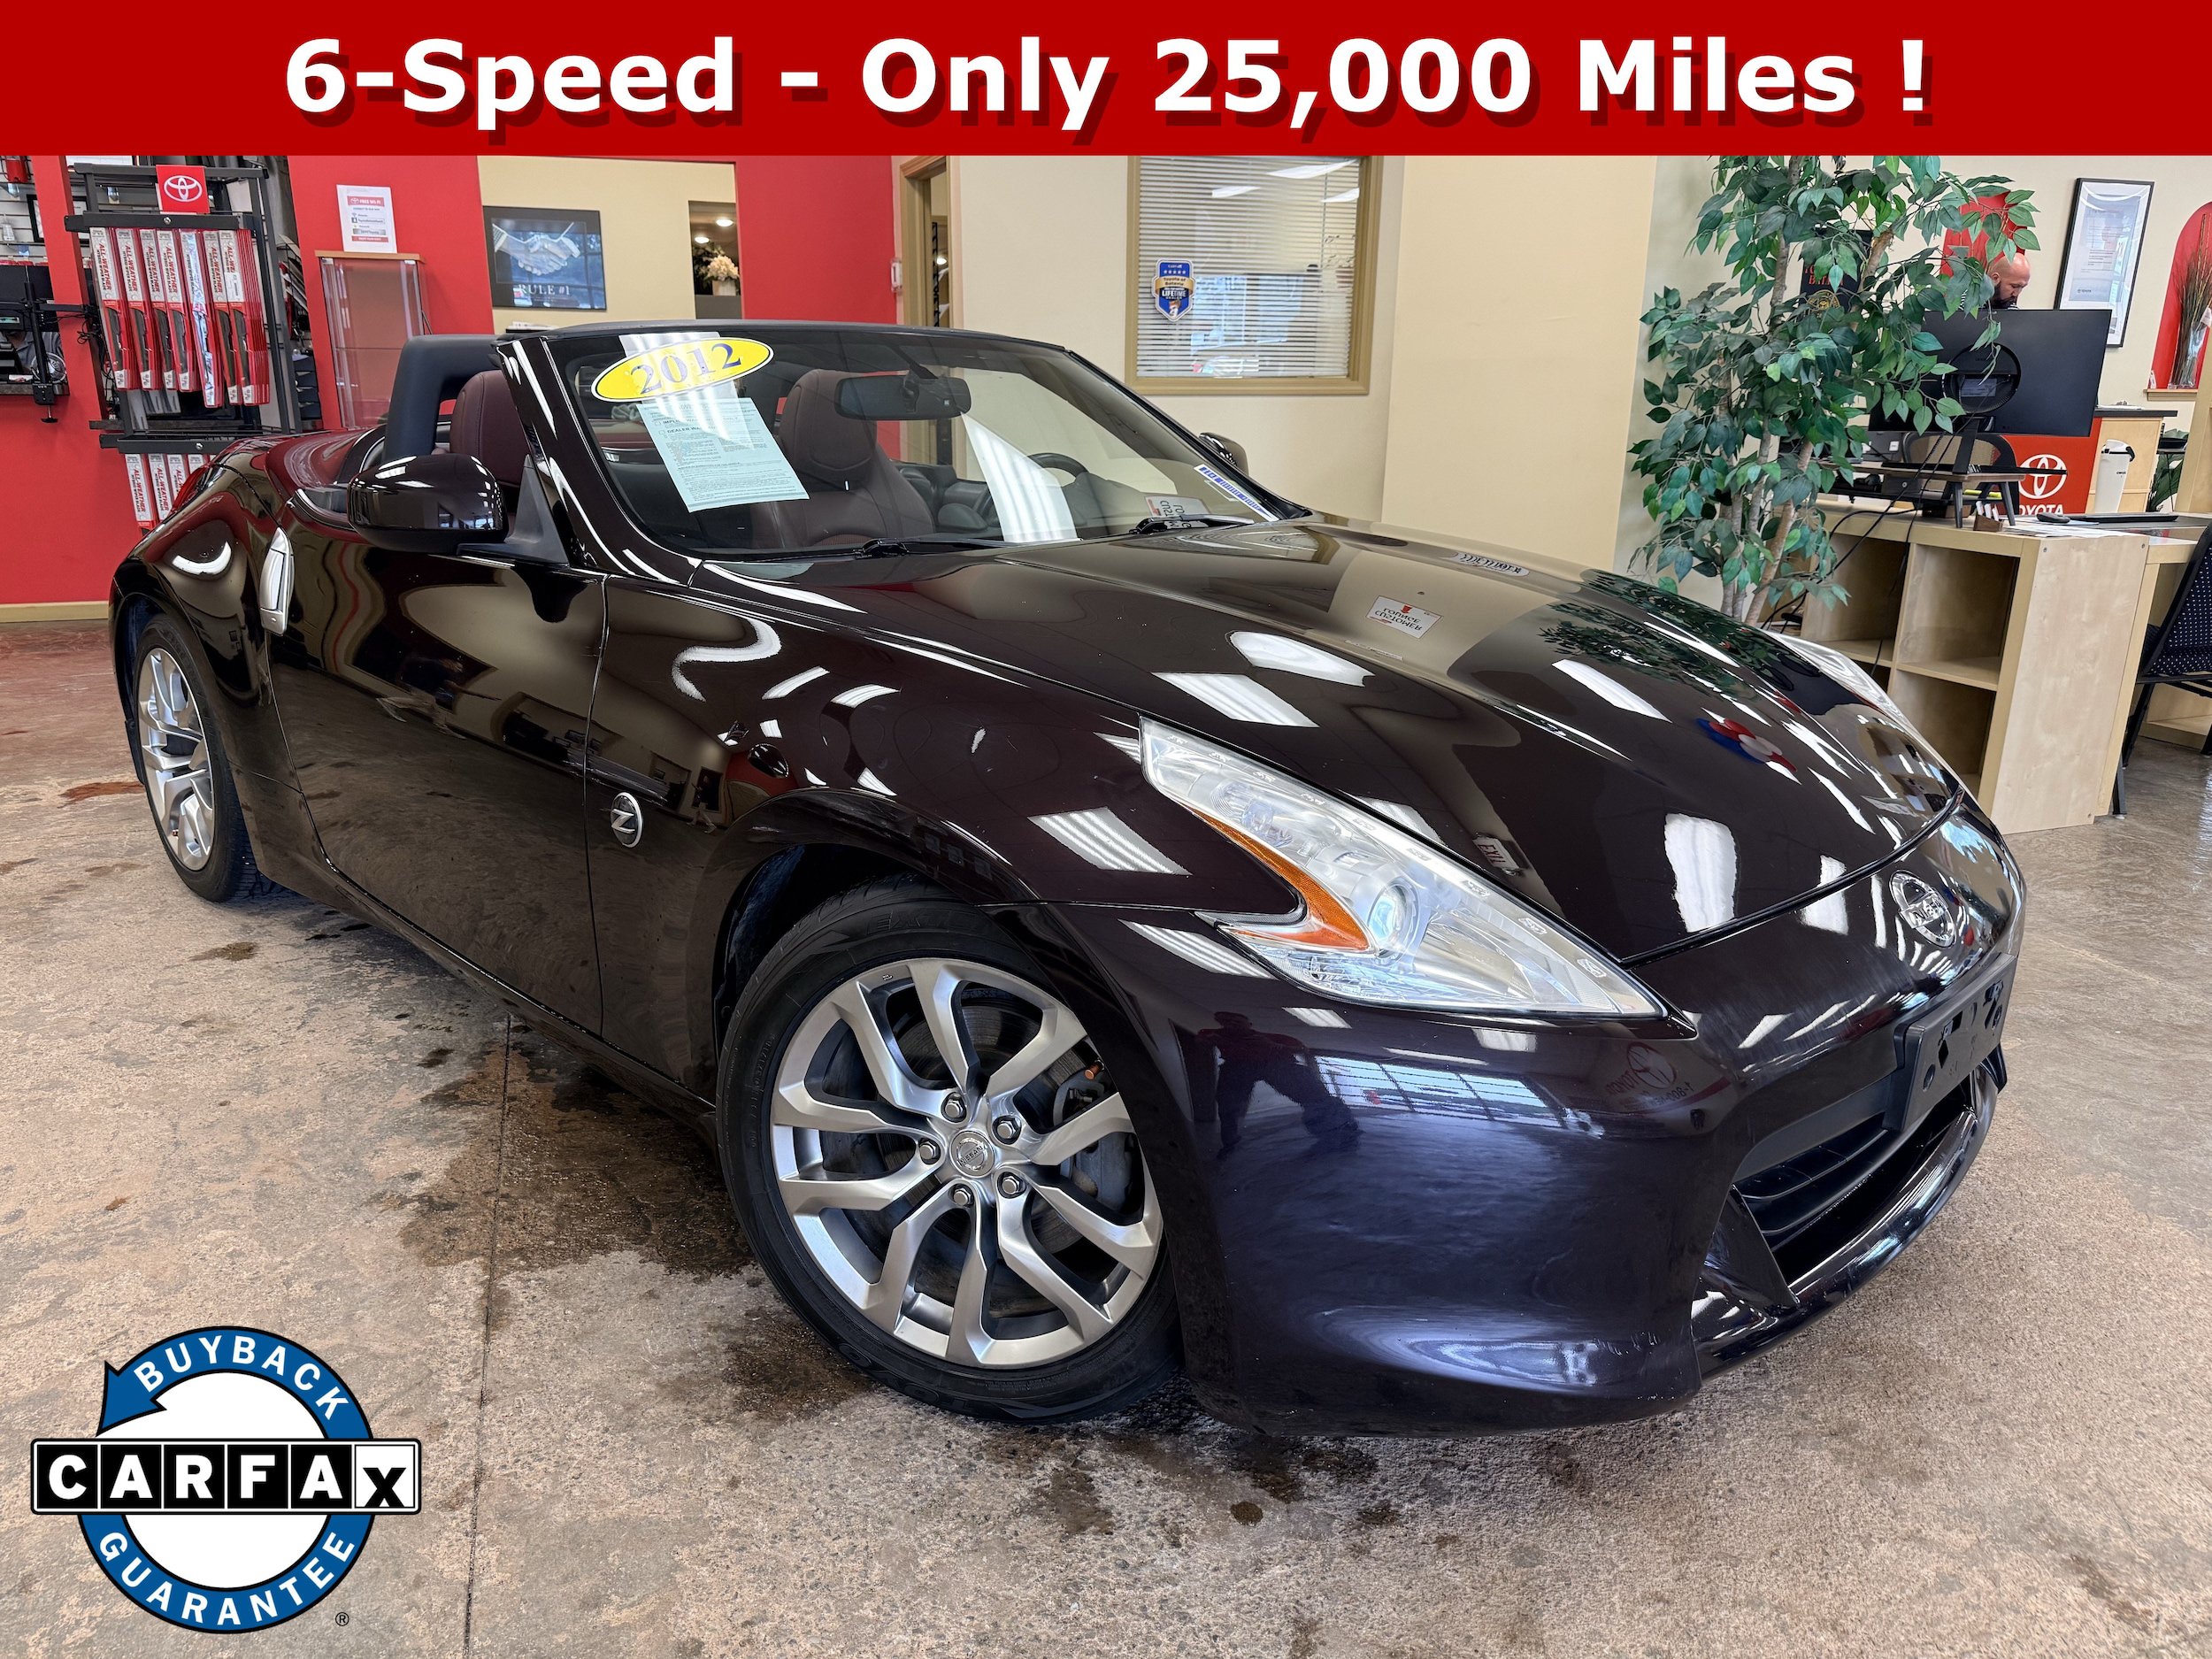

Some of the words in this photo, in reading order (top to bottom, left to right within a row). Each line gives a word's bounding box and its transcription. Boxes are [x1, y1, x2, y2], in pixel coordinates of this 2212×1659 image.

[99, 243, 111, 290] ALL-WEATHER
[126, 245, 137, 291] ALL-WEATHER
[148, 246, 159, 292] ALL-WEATHER
[166, 247, 178, 293] ALL-WEATHER
[211, 247, 222, 293] ALL-WEATHER
[518, 284, 556, 296] RULE
[558, 285, 571, 296] #1
[630, 342, 741, 396] 2012
[134, 469, 146, 512] ALL-WEATHER
[157, 468, 169, 511] ALL-WEATHER
[2019, 504, 2063, 515] OYOTA
[959, 1145, 985, 1166] NISSAN
